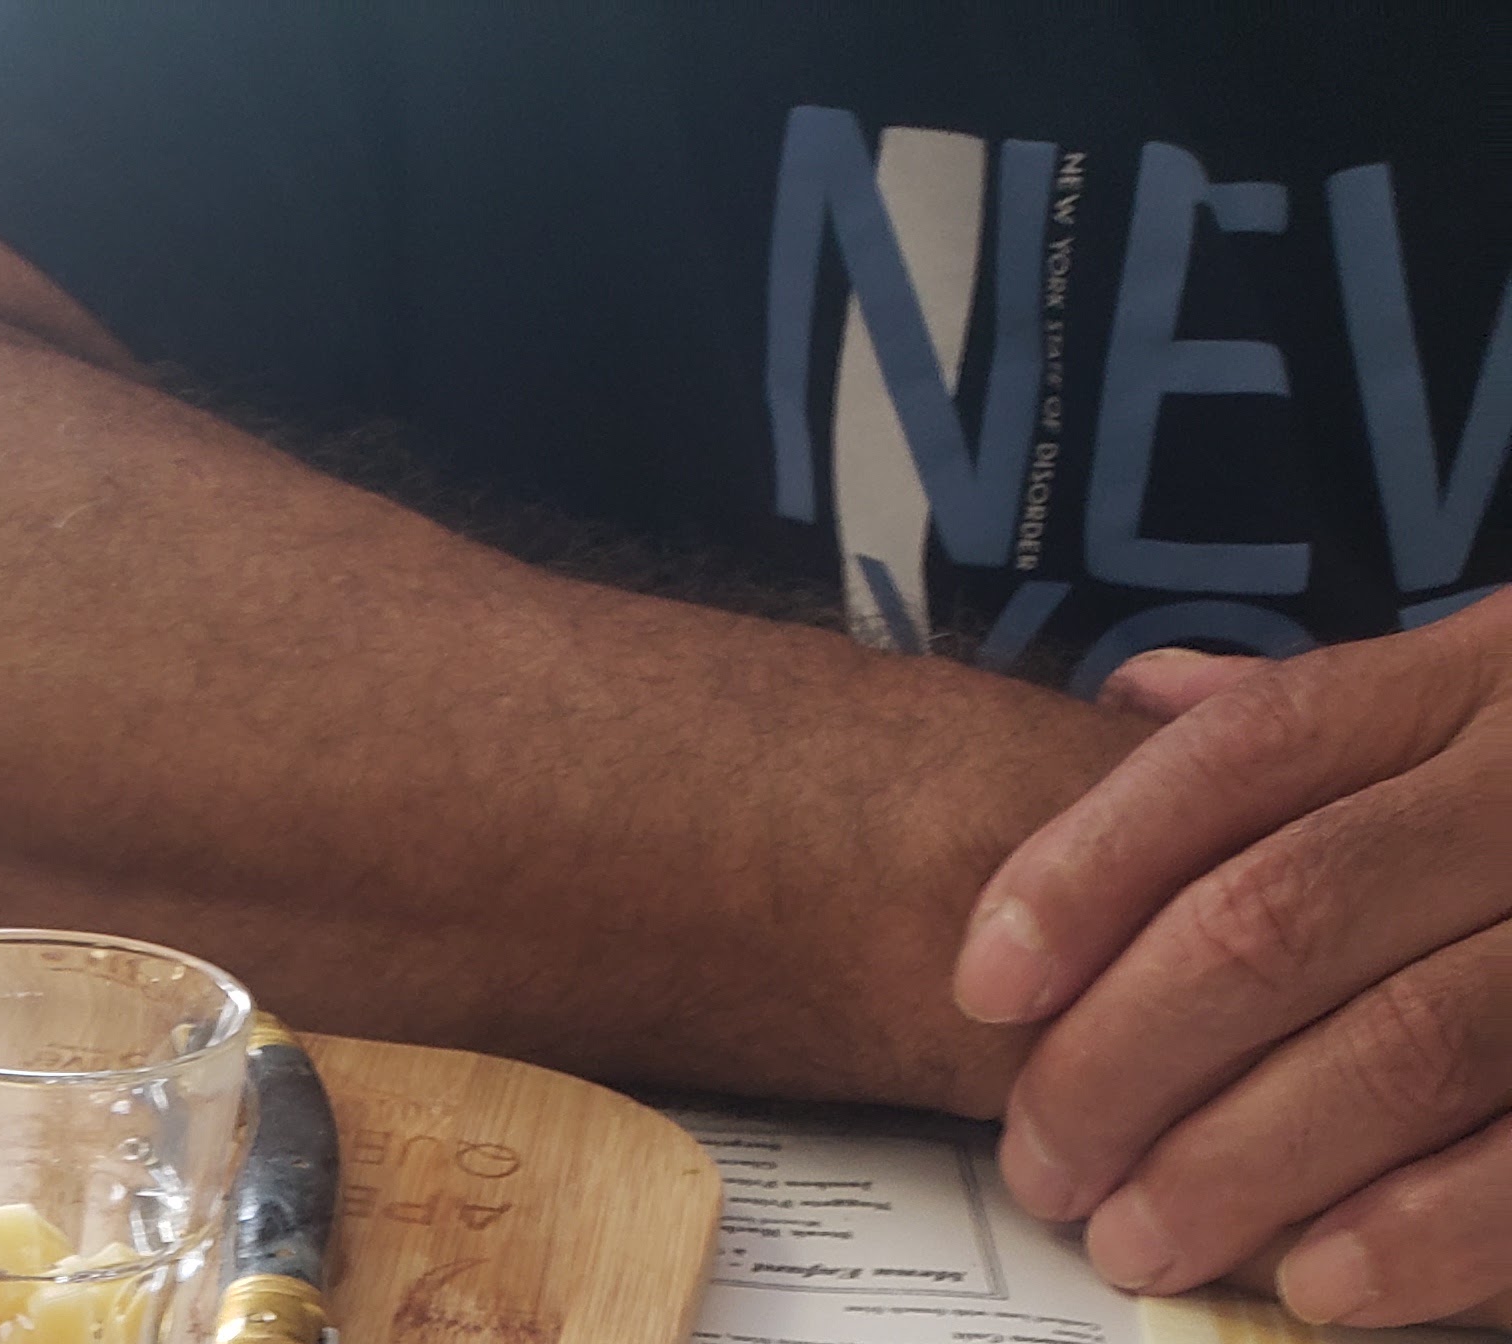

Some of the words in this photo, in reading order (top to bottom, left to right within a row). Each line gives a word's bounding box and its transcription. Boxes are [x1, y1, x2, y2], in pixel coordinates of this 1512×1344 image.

[1052, 151, 1086, 225] NEW
[1045, 237, 1077, 306] YORK
[1015, 442, 1061, 571] DISORDER
